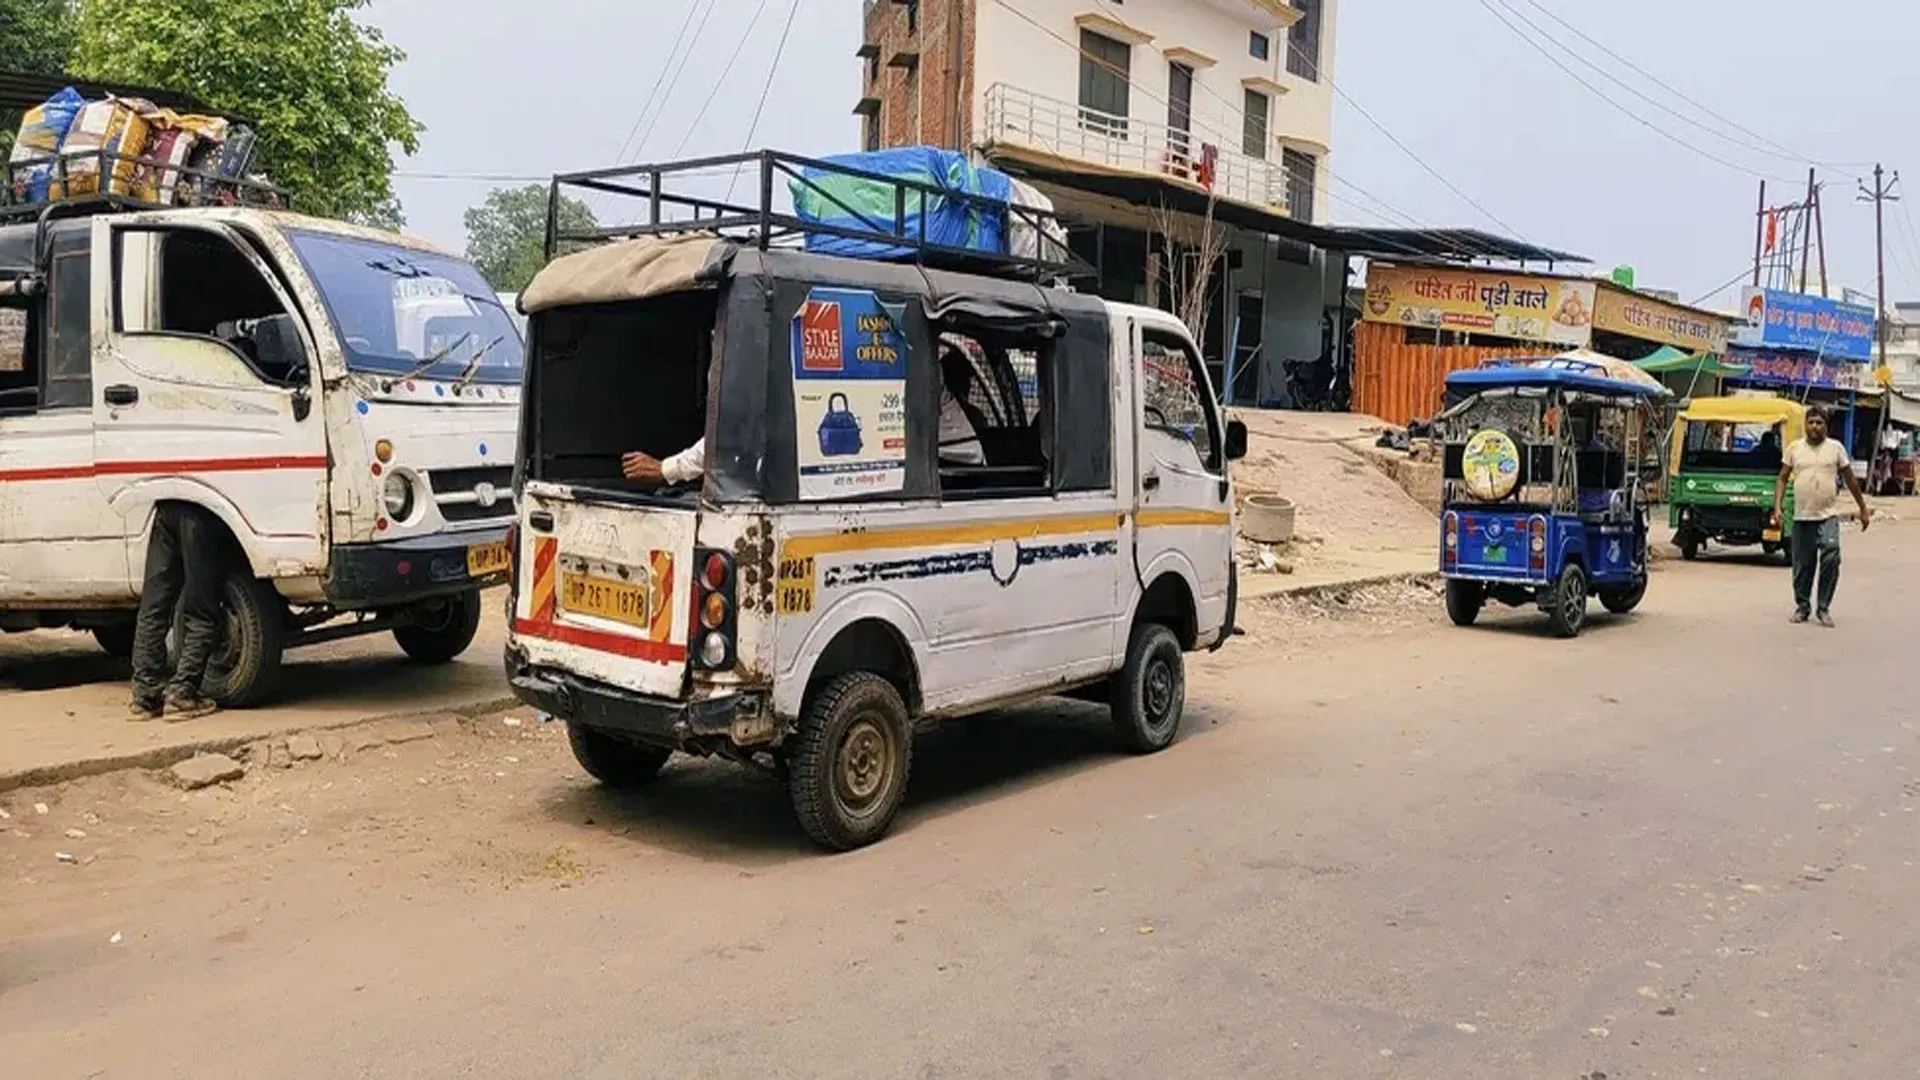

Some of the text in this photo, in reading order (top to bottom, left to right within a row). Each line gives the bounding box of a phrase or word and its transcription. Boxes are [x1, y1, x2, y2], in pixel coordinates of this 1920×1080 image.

[1456, 278, 1477, 303] जी
[1513, 284, 1549, 310] वाले
[804, 328, 838, 347] STYLE
[805, 346, 839, 360] BAAZAR
[856, 346, 898, 364] OFFERS
[571, 580, 585, 604] UP
[588, 584, 602, 608] 26
[616, 590, 644, 617] 1878
[783, 587, 812, 613] 1878
